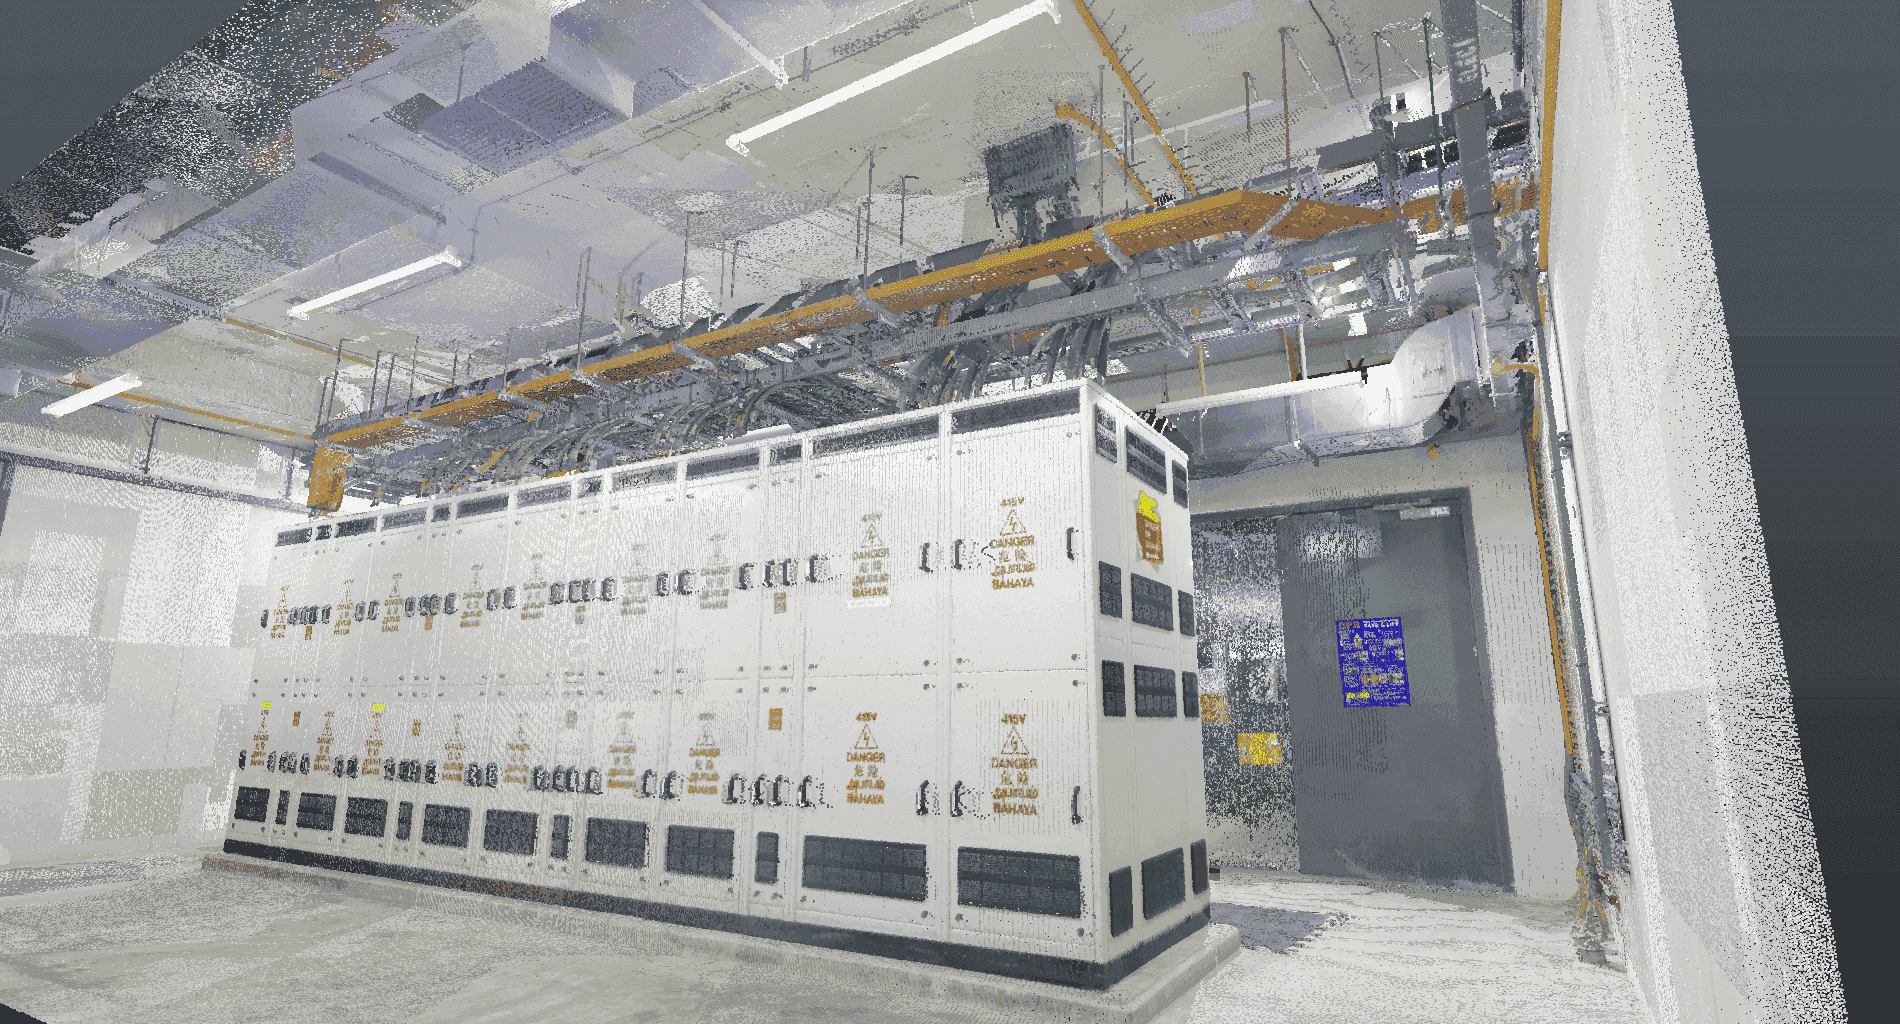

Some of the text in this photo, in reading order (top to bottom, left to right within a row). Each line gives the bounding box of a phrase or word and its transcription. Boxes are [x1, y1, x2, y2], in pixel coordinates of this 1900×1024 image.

[846, 752, 886, 763] DANGER
[991, 757, 1038, 769] DANGER
[846, 793, 885, 805] BAHAYA
[993, 802, 1038, 815] BAHAYA
